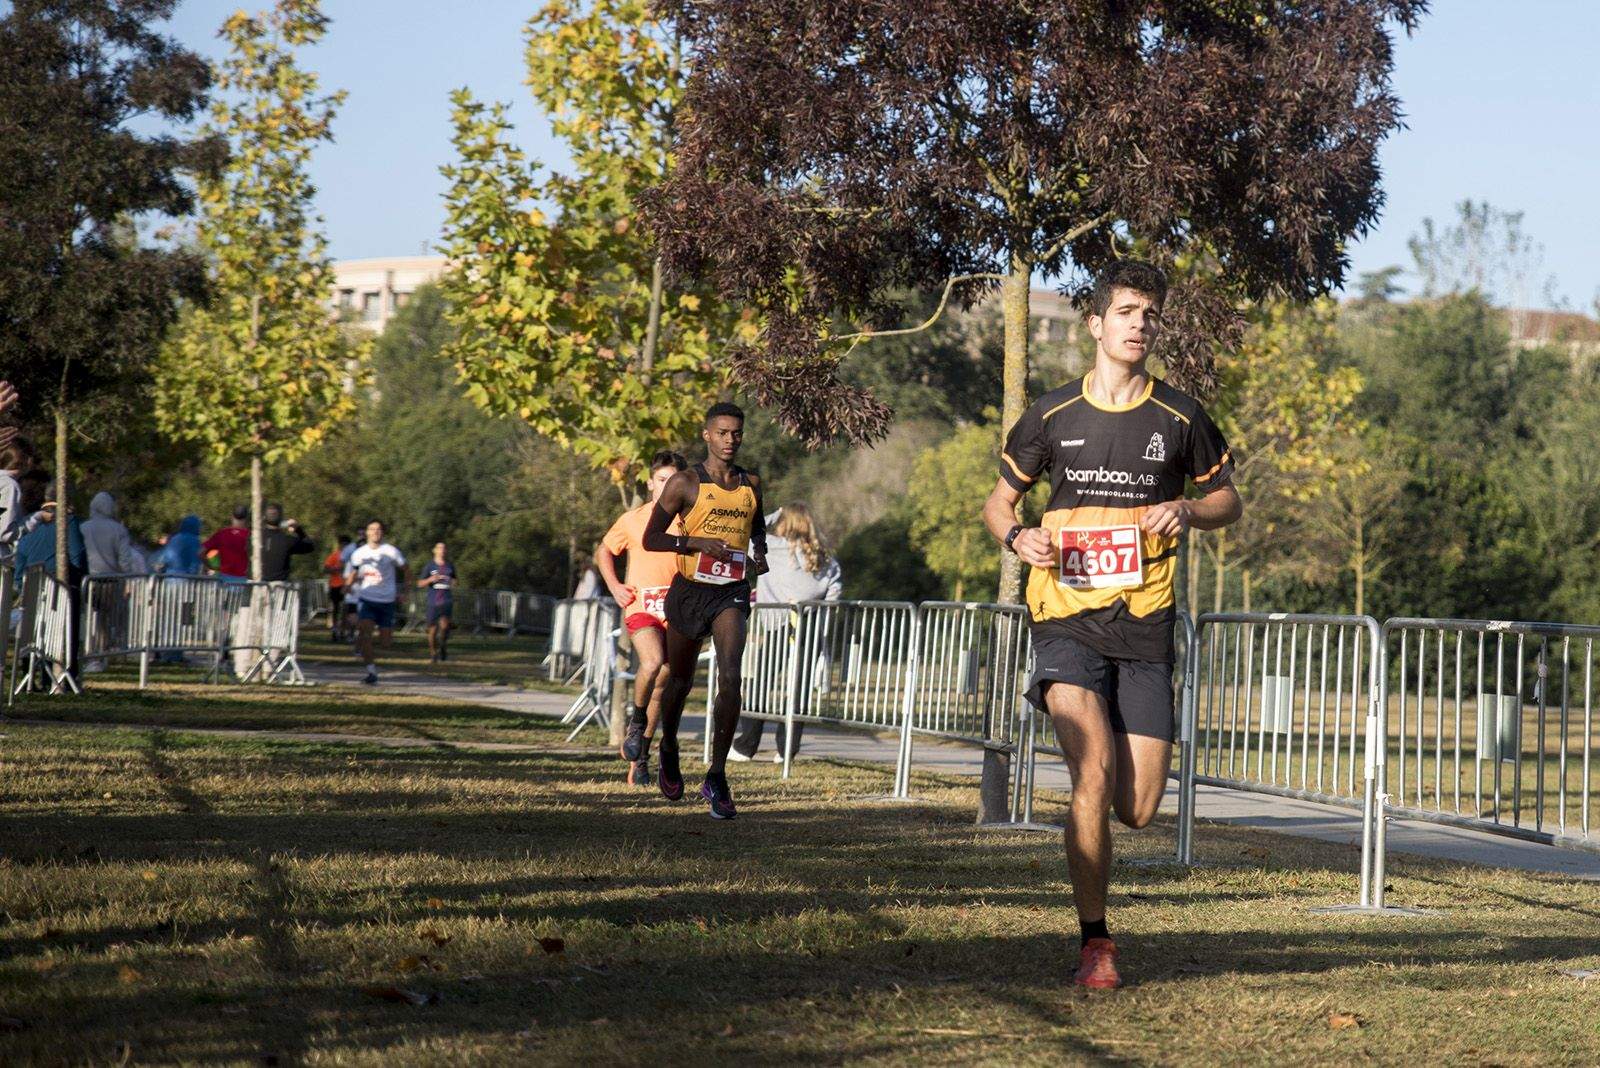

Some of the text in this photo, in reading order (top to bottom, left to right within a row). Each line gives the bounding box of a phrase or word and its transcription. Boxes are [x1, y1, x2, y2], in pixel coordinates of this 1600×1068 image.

[1065, 466, 1160, 486] bambooLABS
[711, 561, 732, 577] 61
[1066, 549, 1135, 575] 4607
